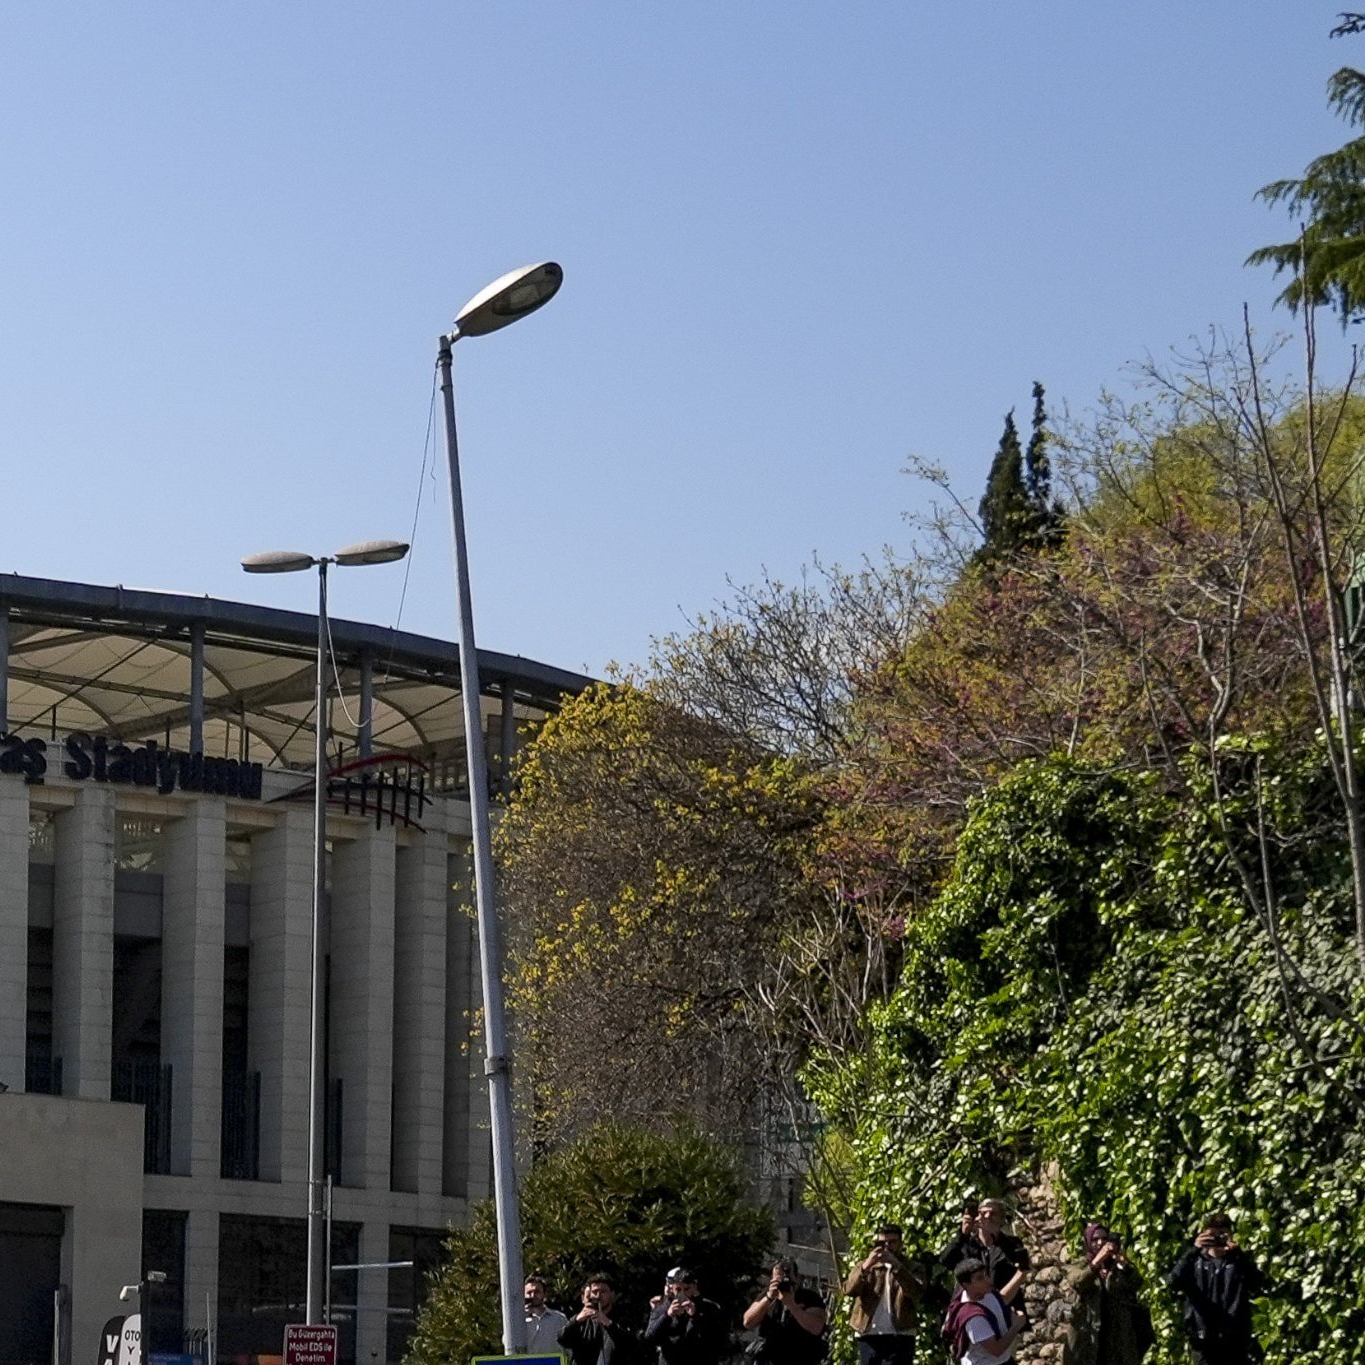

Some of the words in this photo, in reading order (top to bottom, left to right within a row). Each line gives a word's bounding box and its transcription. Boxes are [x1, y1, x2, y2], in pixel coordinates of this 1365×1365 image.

[125, 1329, 140, 1341] OTO
[289, 1342, 308, 1351] Mobil
[309, 1342, 323, 1352] EDS
[295, 1352, 326, 1362] Denetim
